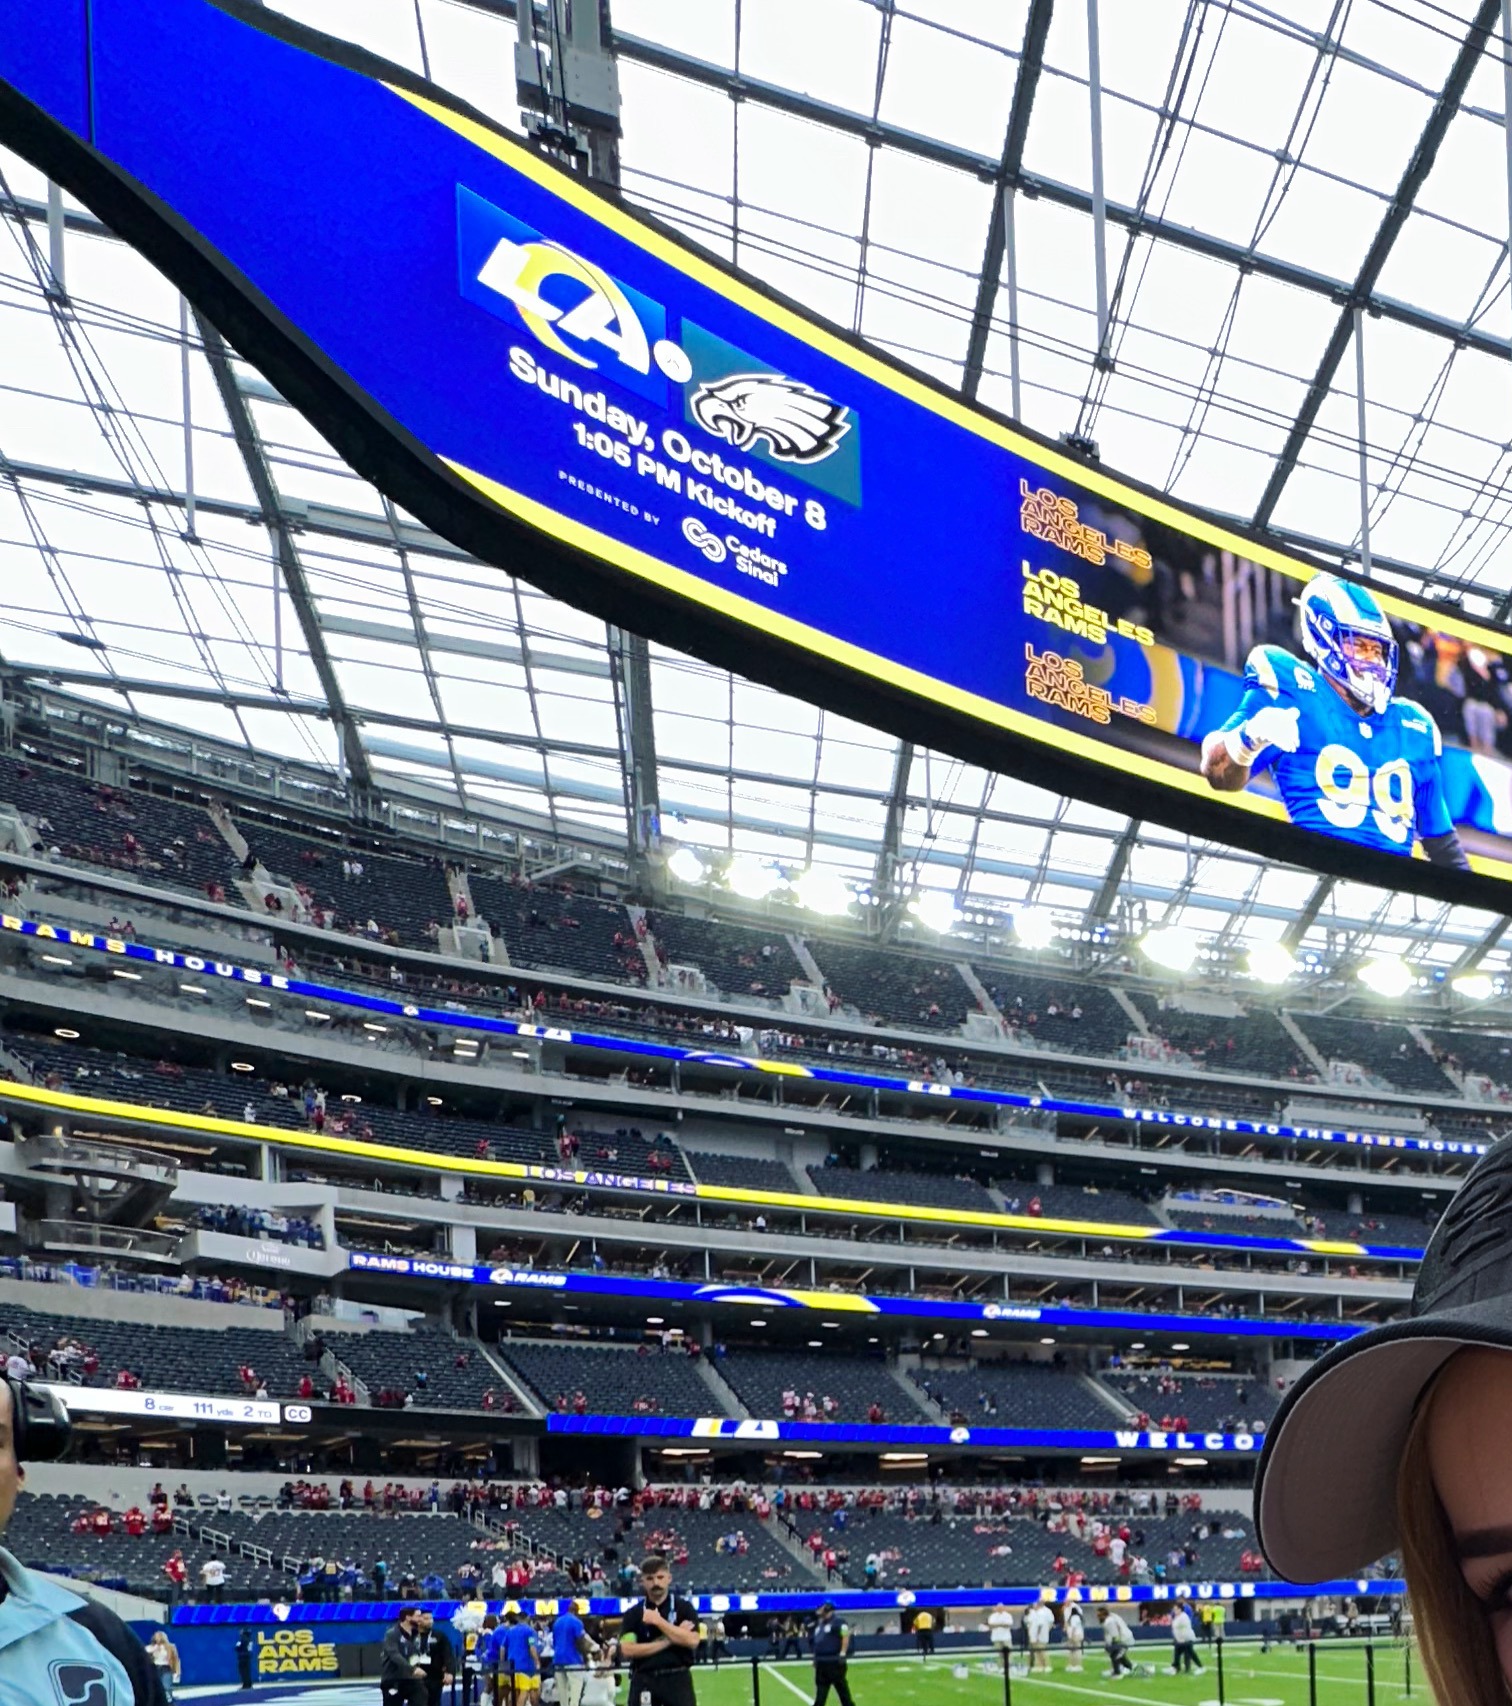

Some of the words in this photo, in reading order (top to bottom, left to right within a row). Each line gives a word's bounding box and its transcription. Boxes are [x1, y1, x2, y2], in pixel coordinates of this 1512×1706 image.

[509, 347, 655, 453] Sunday,
[662, 430, 798, 517] October
[804, 499, 827, 531] 8
[558, 470, 639, 517] PRESENTED
[643, 510, 660, 526] BY
[573, 422, 632, 468] 1:05
[637, 453, 682, 493] PM
[686, 477, 777, 538] Kickoff
[1020, 478, 1078, 519] LOS
[1020, 498, 1152, 569] ANGELES
[1021, 514, 1105, 566] RAMS
[725, 534, 788, 576] Cedars
[736, 558, 779, 587] Sinai
[1022, 560, 1080, 599] LOS
[1022, 581, 1155, 646] ANGELES
[1023, 596, 1107, 645] RAMS
[1025, 642, 1083, 681] LOS
[1026, 662, 1157, 724] ANGELES
[1026, 677, 1111, 725] RAMS
[1315, 744, 1415, 844] 99
[1, 915, 126, 953] RAMS
[154, 950, 289, 989] HOUSE
[1123, 1108, 1237, 1130] WELCOME
[1253, 1123, 1279, 1134] TO
[1293, 1128, 1333, 1141] THE
[353, 1254, 408, 1272] RAMS
[413, 1261, 475, 1279] HOUSE
[193, 1402, 214, 1415] 111
[243, 1405, 254, 1418] 2
[1115, 1431, 1254, 1450] WELCO
[1040, 1585, 1132, 1601] RAMS
[1153, 1582, 1256, 1600] HOUSE
[258, 1629, 314, 1645] LOS
[258, 1642, 336, 1659] ANGE
[258, 1656, 339, 1674] RAMS
